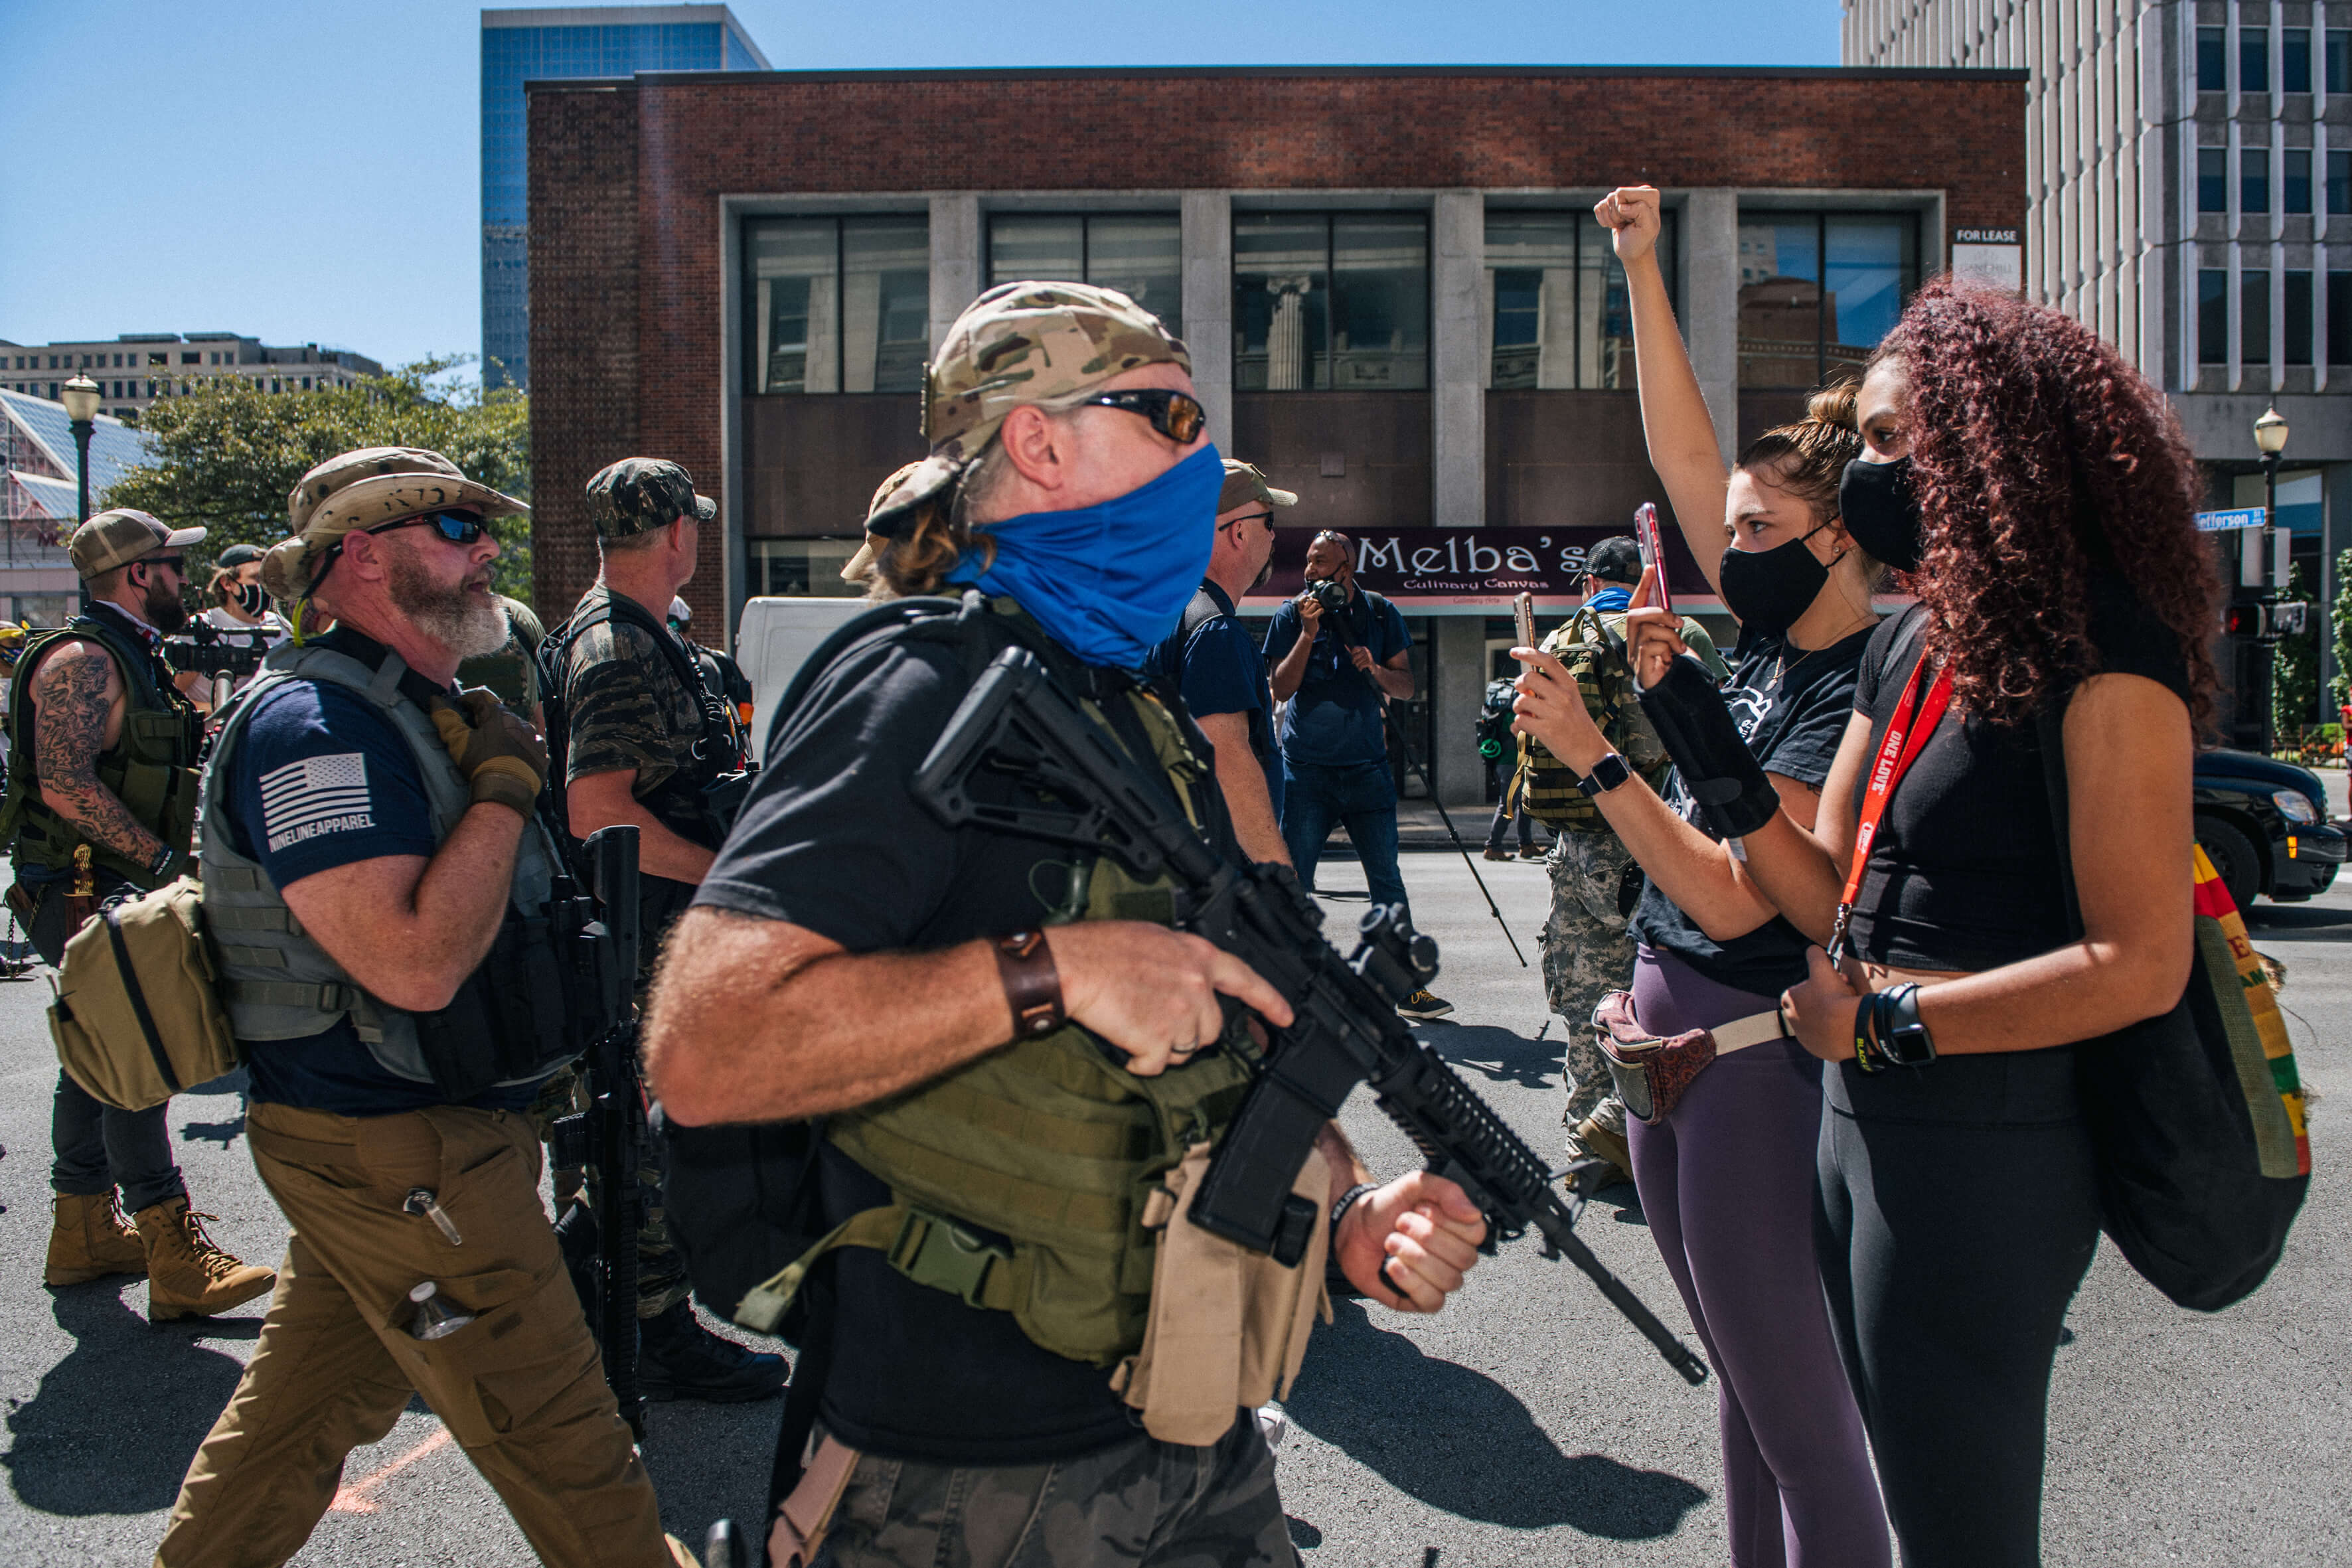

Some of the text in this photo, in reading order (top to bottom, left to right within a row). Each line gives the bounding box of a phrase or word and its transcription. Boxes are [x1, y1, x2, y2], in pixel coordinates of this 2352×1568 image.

[1957, 230, 2017, 242] FOR LEASE
[1355, 535, 1589, 576] Melba's
[1403, 578, 1549, 591] Culinary Canvas
[1884, 730, 1902, 759] ONE
[268, 814, 377, 853] NINELINEAPPAREL
[1856, 1038, 1867, 1064] BLACK
